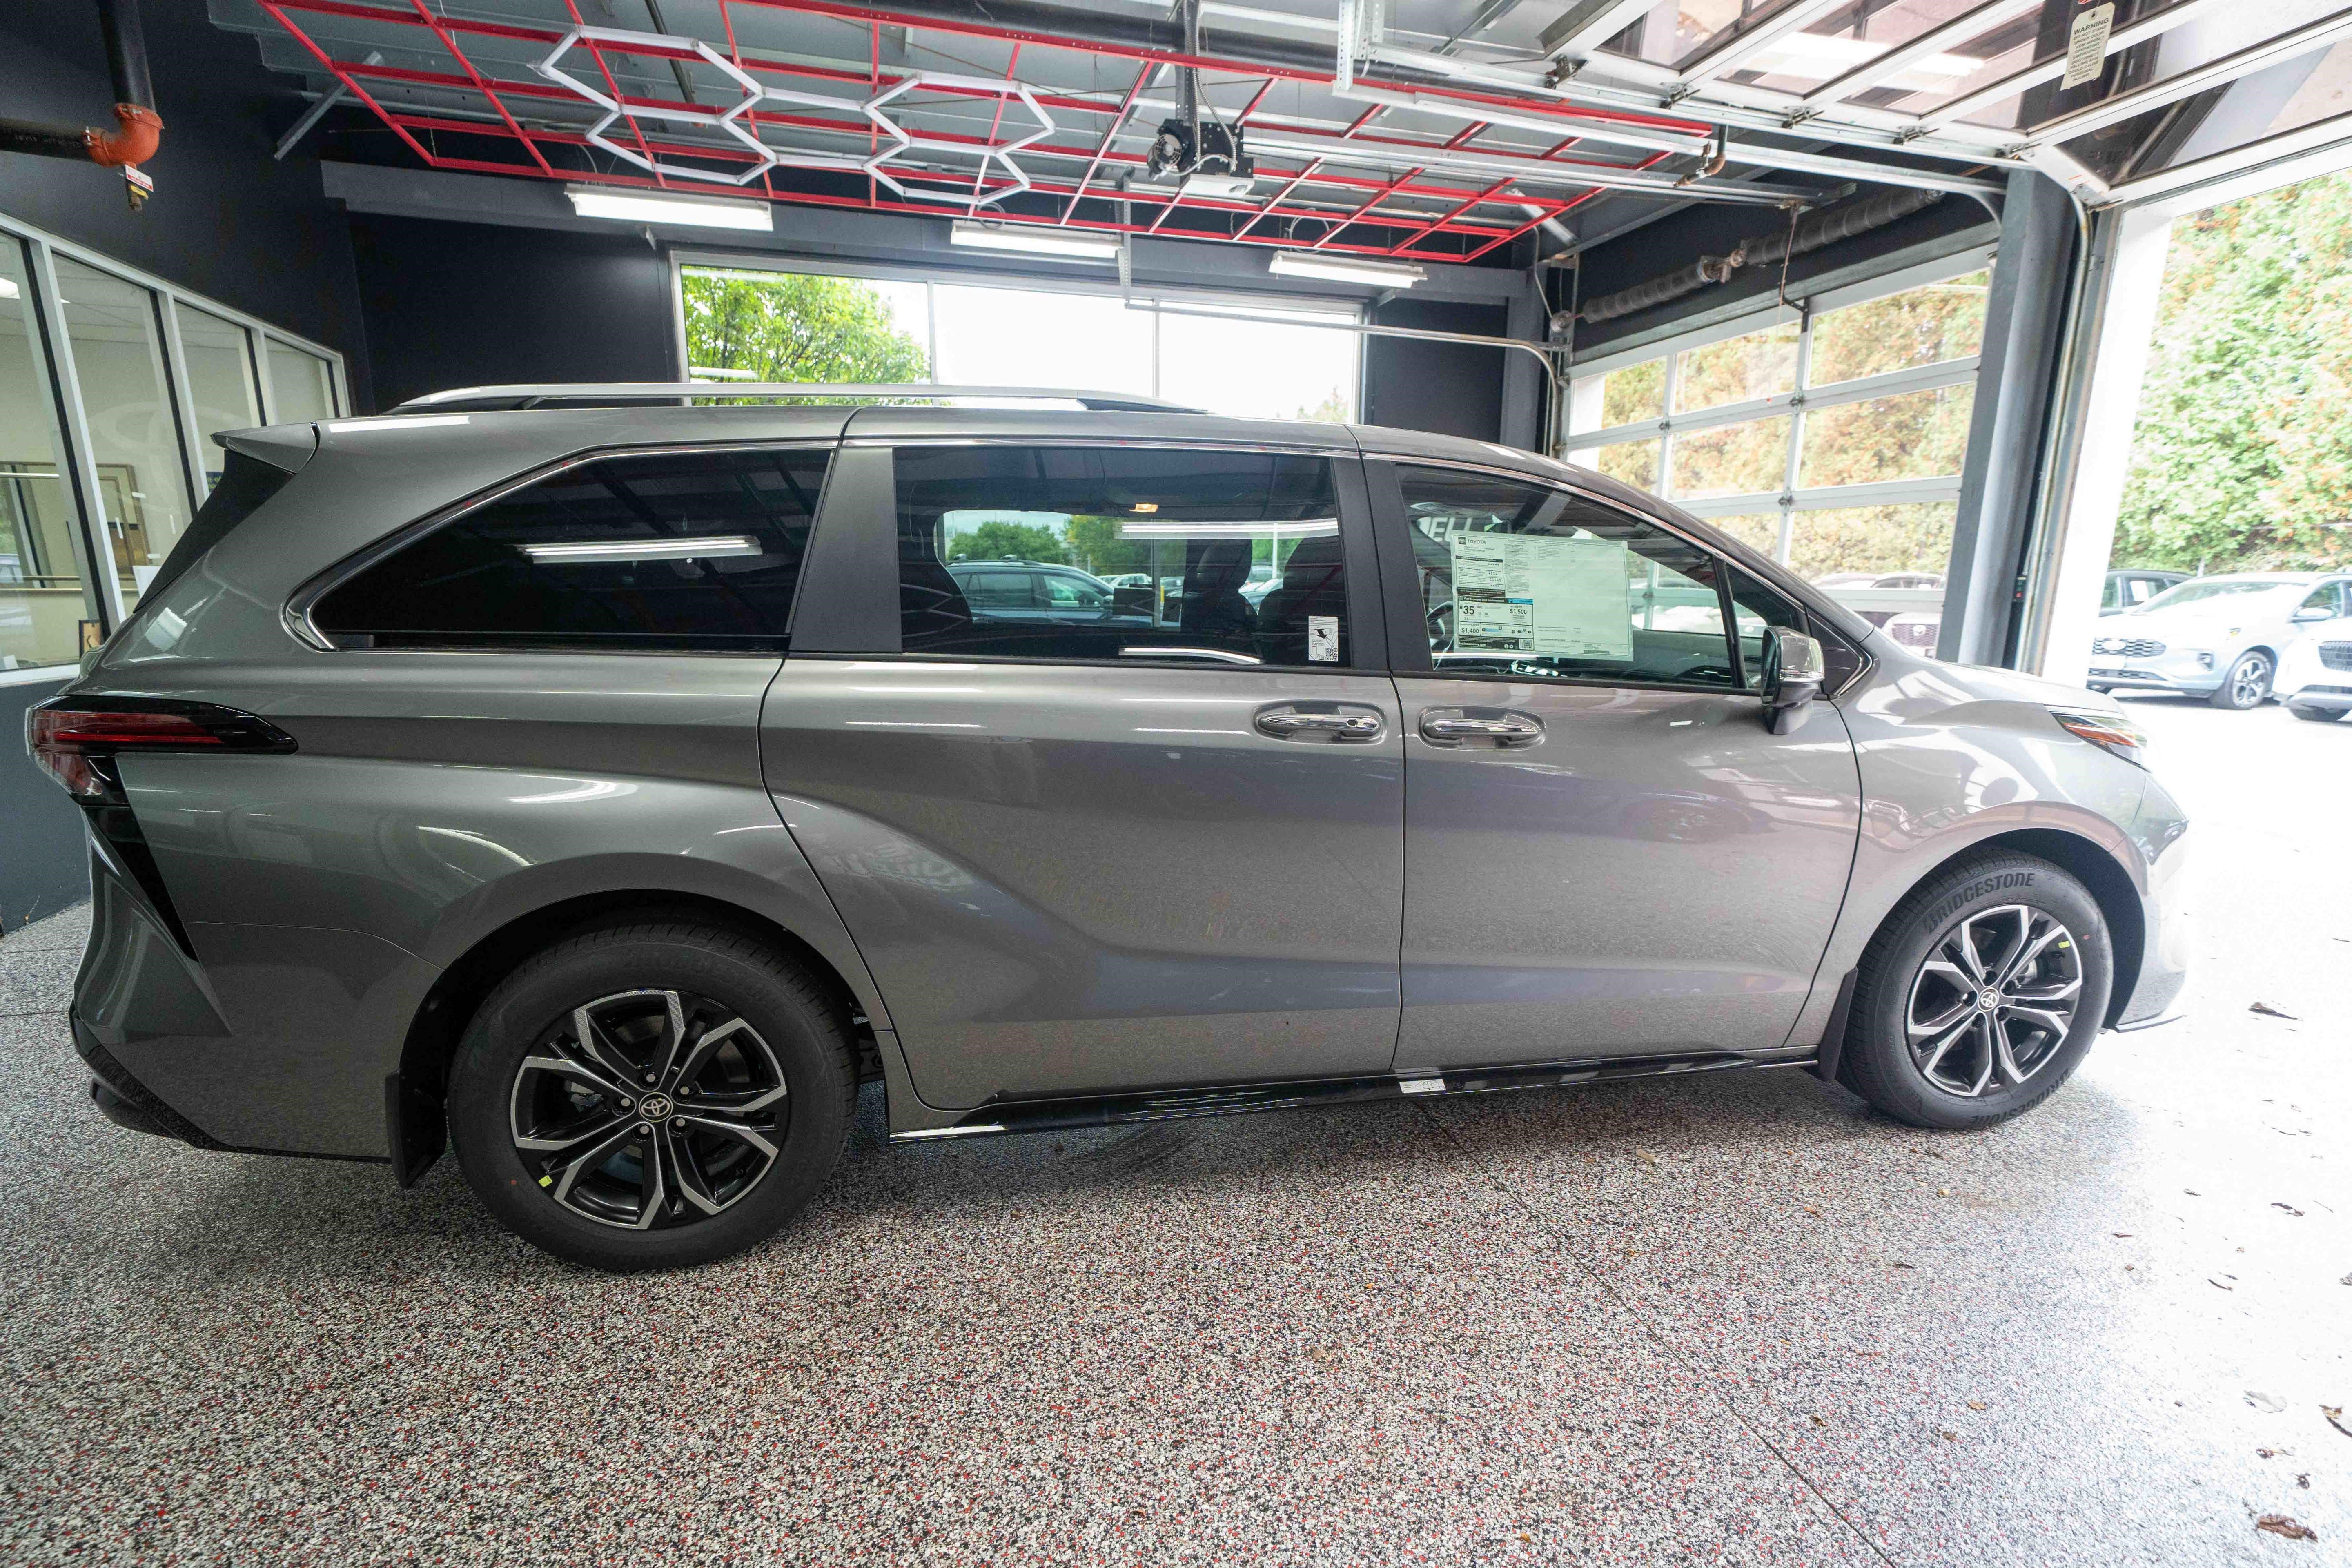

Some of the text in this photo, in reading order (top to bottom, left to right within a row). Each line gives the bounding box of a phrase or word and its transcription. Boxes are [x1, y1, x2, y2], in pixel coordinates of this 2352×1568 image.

[2074, 18, 2109, 34] WARNING
[2074, 36, 2090, 45] UNDER
[2073, 47, 2100, 59] EMERGENCY
[2075, 42, 2100, 53] OPERATING
[2071, 51, 2099, 65] DISCONNECT
[2069, 66, 2083, 74] COULD
[2071, 60, 2088, 69] FALLING
[2071, 67, 2094, 78] PERSONAL
[1463, 606, 1474, 615] 35
[1925, 873, 2035, 935] BRIDGESTONE
